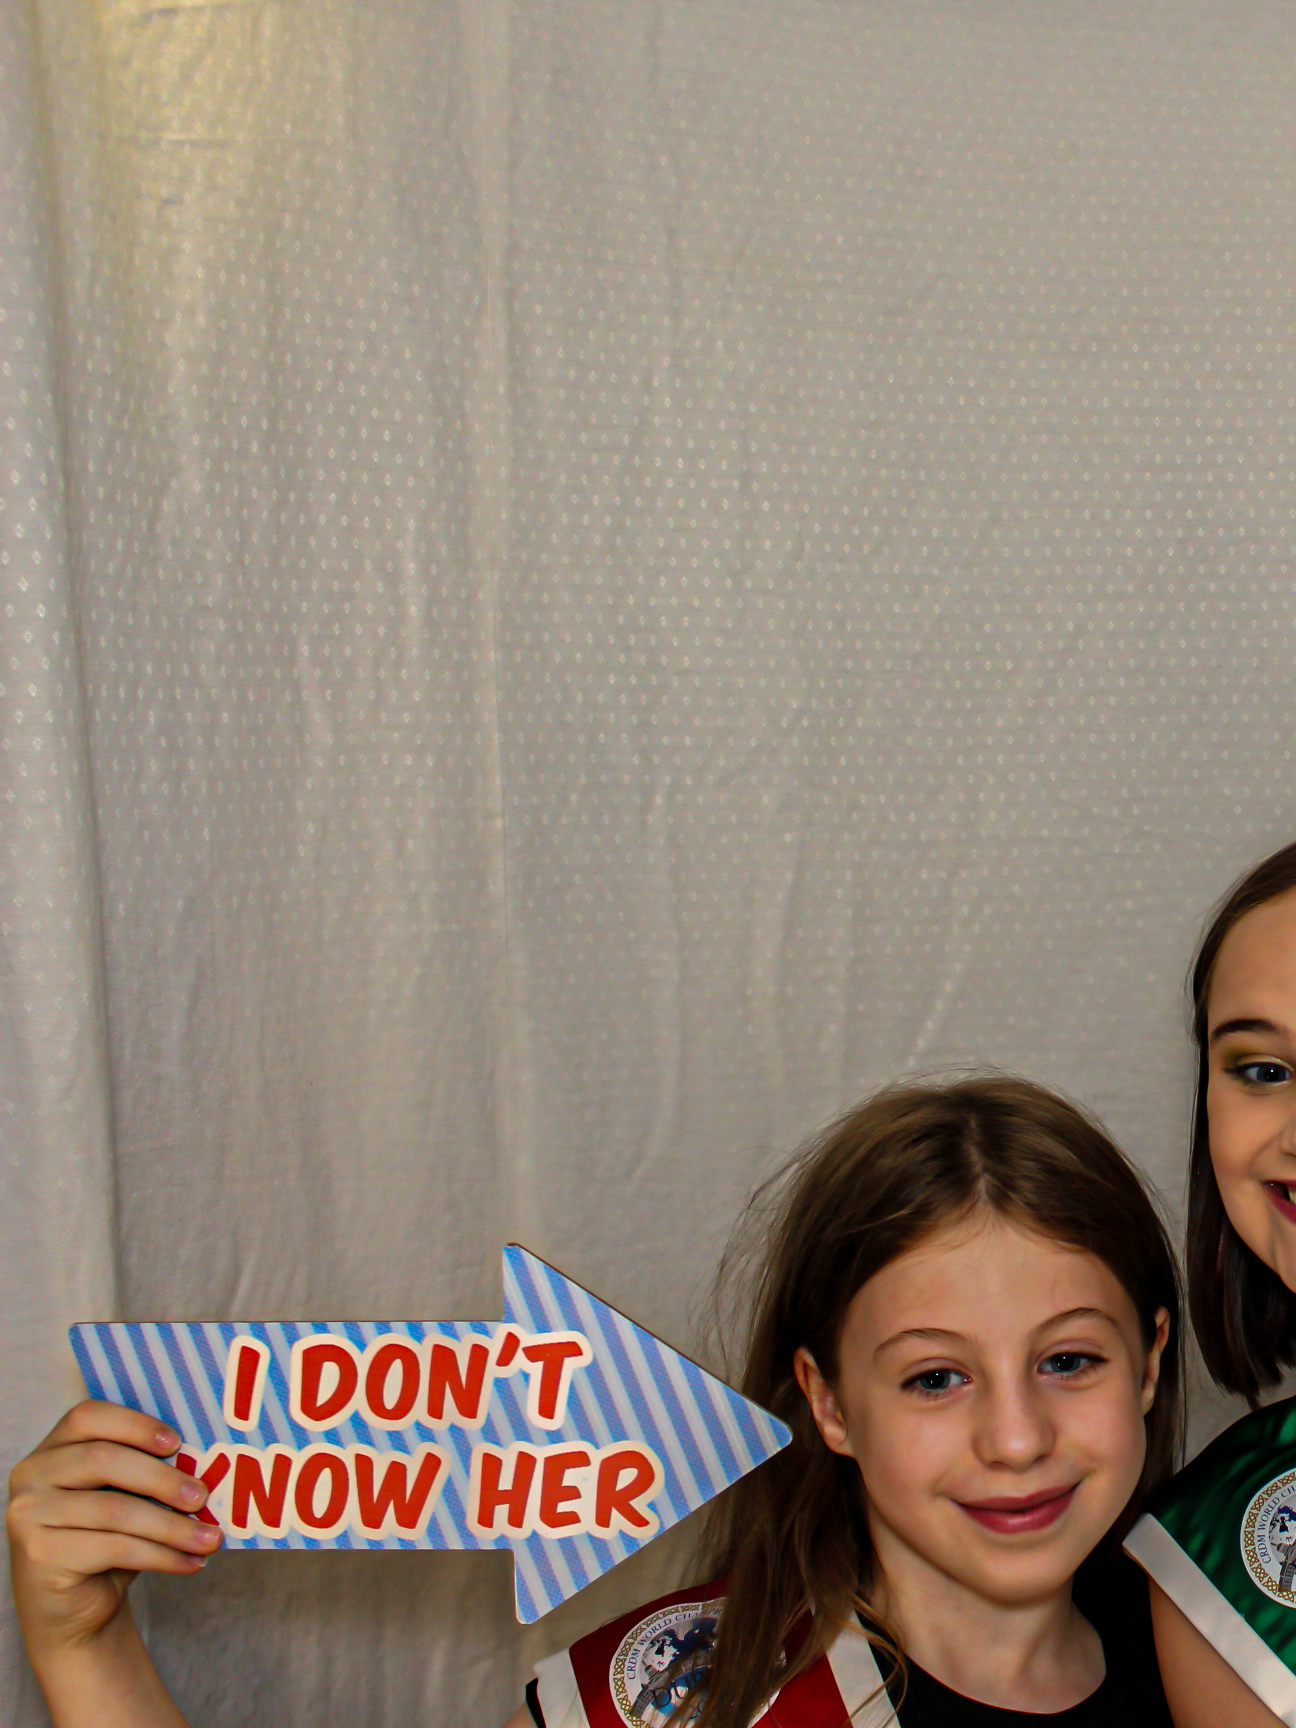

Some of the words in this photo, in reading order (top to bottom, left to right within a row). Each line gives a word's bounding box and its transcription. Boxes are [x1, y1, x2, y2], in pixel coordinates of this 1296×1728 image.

[234, 1344, 261, 1422] I
[300, 1331, 583, 1422] DON'T
[477, 1450, 656, 1529] HER
[1258, 1496, 1280, 1531] WORLD
[1256, 1533, 1272, 1564] CRDM
[626, 1648, 641, 1680] CRDM
[637, 1618, 672, 1647] WORLD
